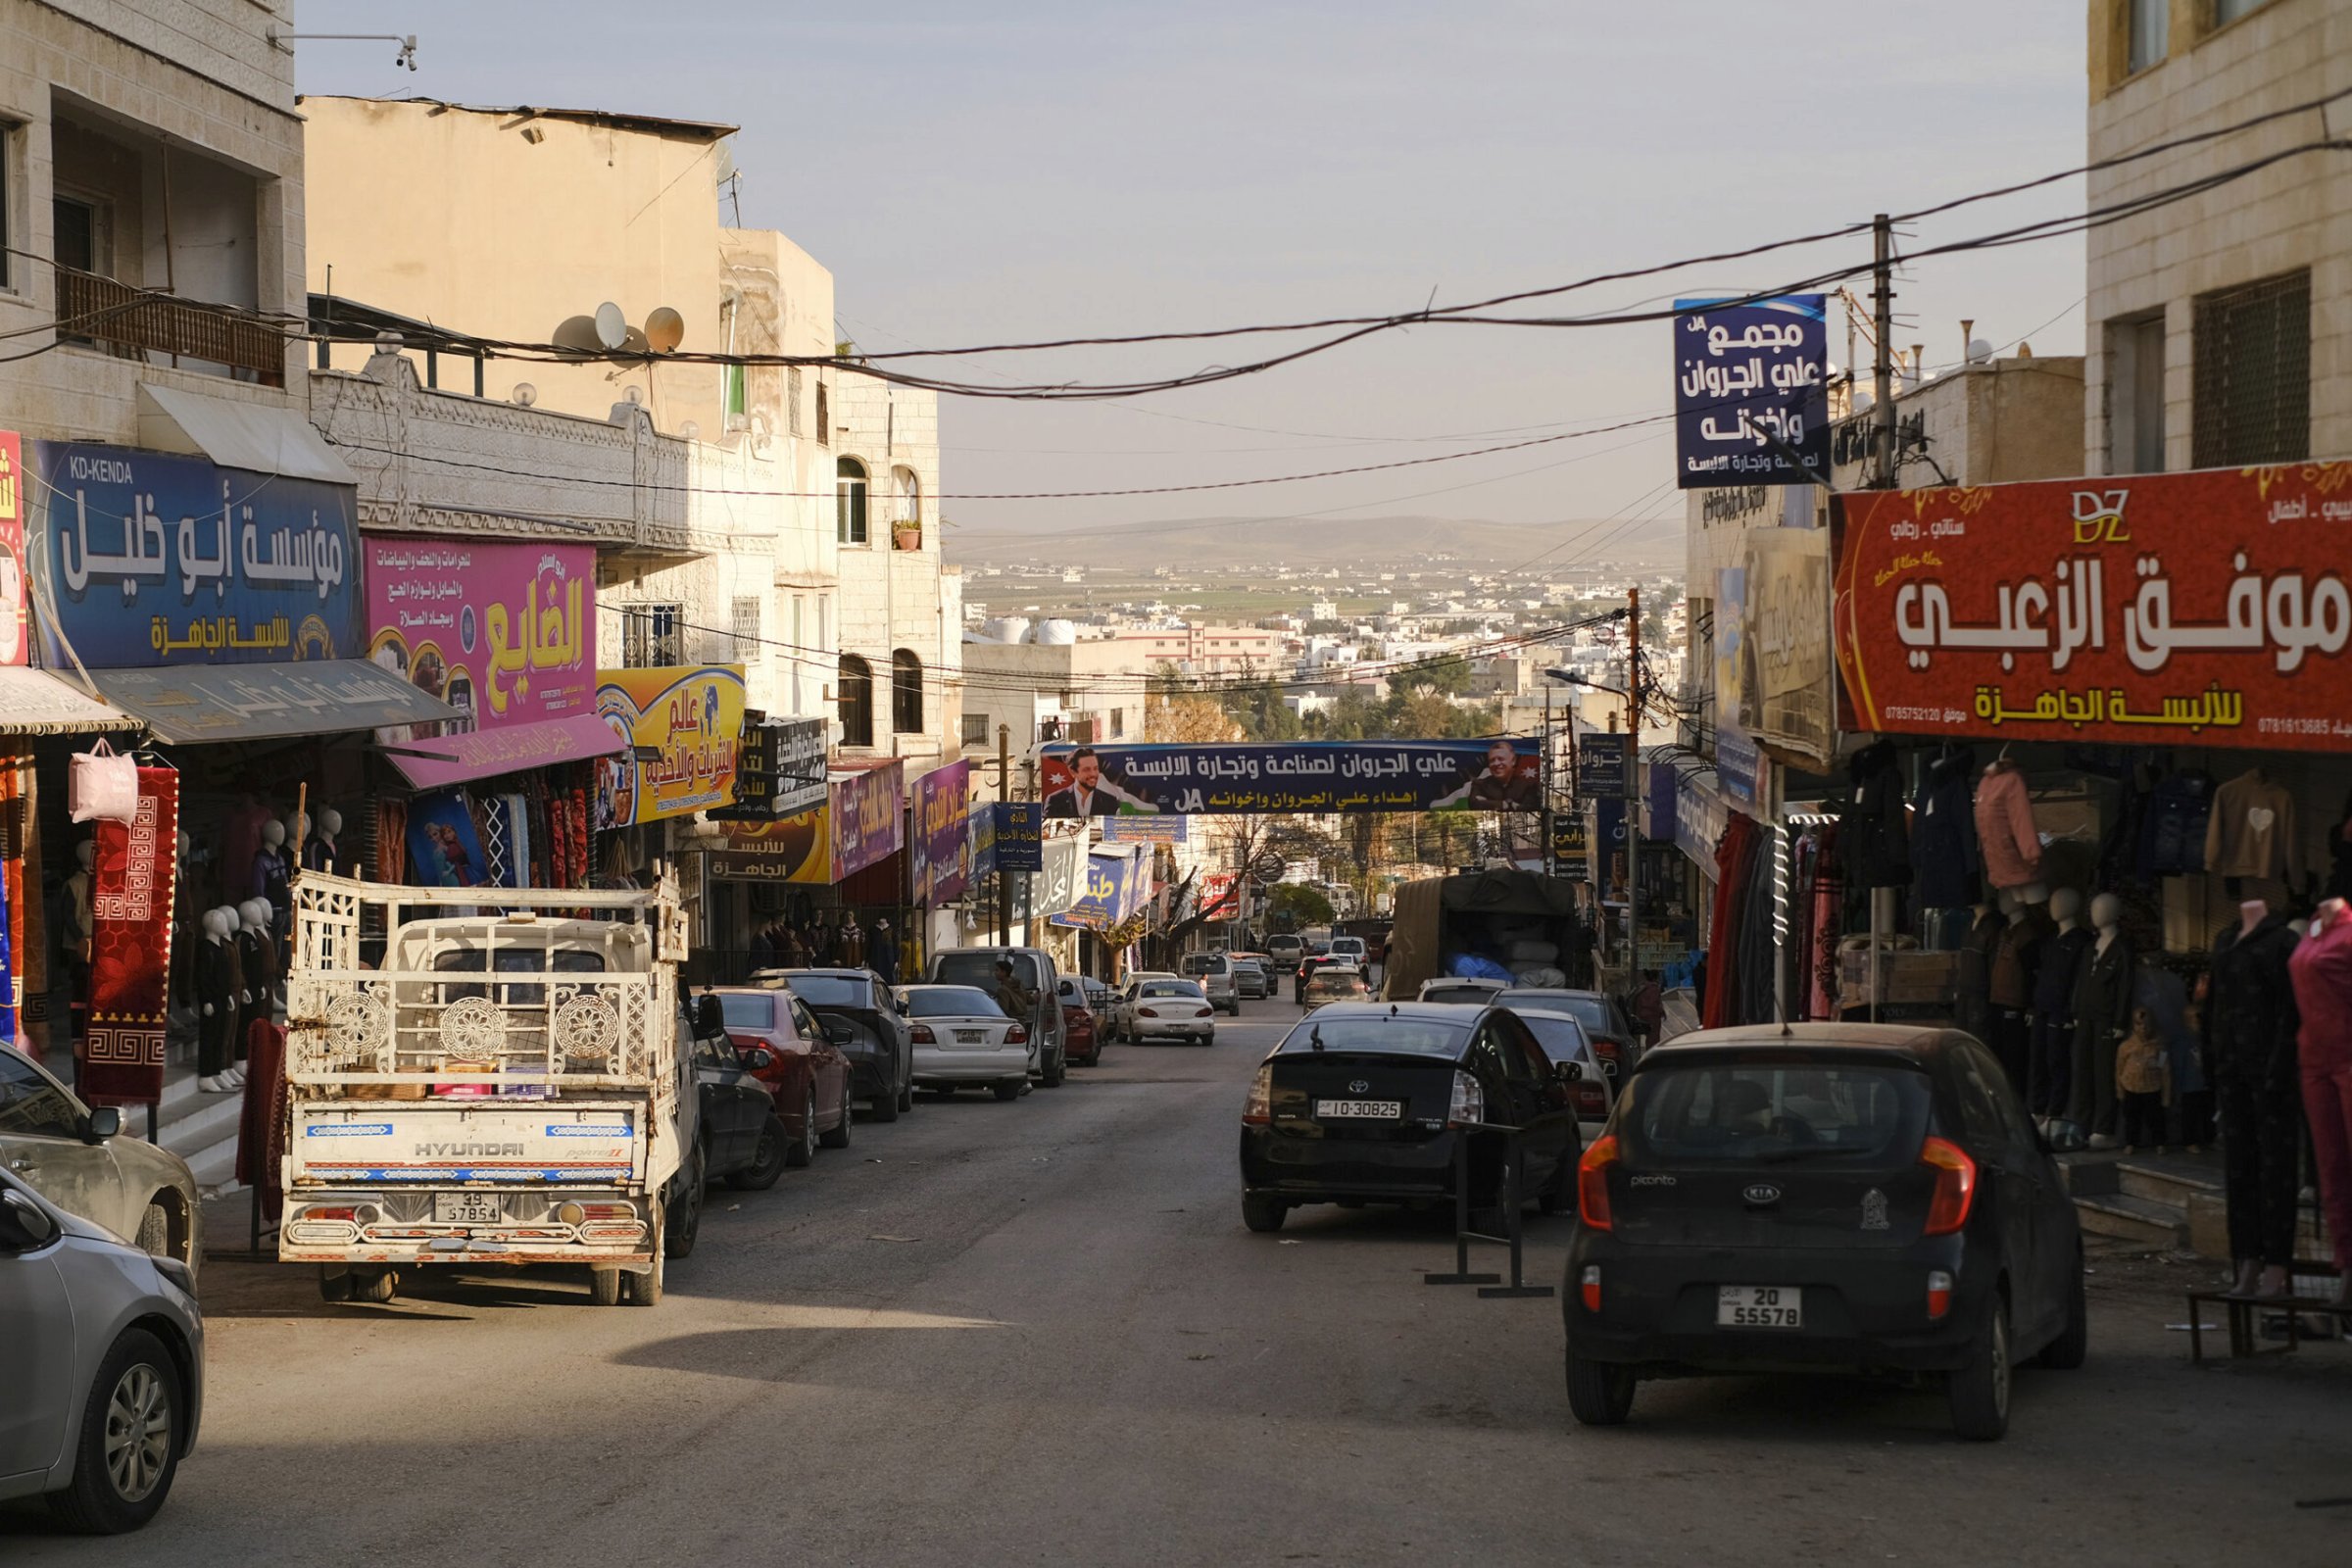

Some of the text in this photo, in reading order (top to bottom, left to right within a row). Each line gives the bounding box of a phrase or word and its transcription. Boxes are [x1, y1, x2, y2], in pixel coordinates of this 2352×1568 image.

[1707, 323, 1803, 356] مجمع
[1682, 356, 1820, 397] علي الجروان
[70, 455, 133, 484] KD-KENDA
[2070, 489, 2132, 544] DZ
[2267, 493, 2307, 524] أطفال
[178, 479, 233, 597] أبو
[242, 505, 342, 600] مؤسسة
[1895, 555, 2104, 670] الزعبي
[2124, 551, 2351, 673] موفق
[151, 616, 226, 655] الجاهزة
[1974, 681, 2242, 730] للألبسة الجاهزة
[1197, 755, 1259, 779] وتجارة
[1266, 753, 1335, 775] لصناعة
[1342, 754, 1409, 777] الجروان
[1415, 753, 1456, 775] علي
[1272, 791, 1333, 808] الجروان
[1336, 791, 1369, 809] علي
[416, 1143, 524, 1156] HYUNDAI
[1750, 1188, 1774, 1198] KIA
[448, 1207, 497, 1220] 57854
[1754, 1289, 1779, 1305] 20
[1735, 1307, 1796, 1325] 55578
